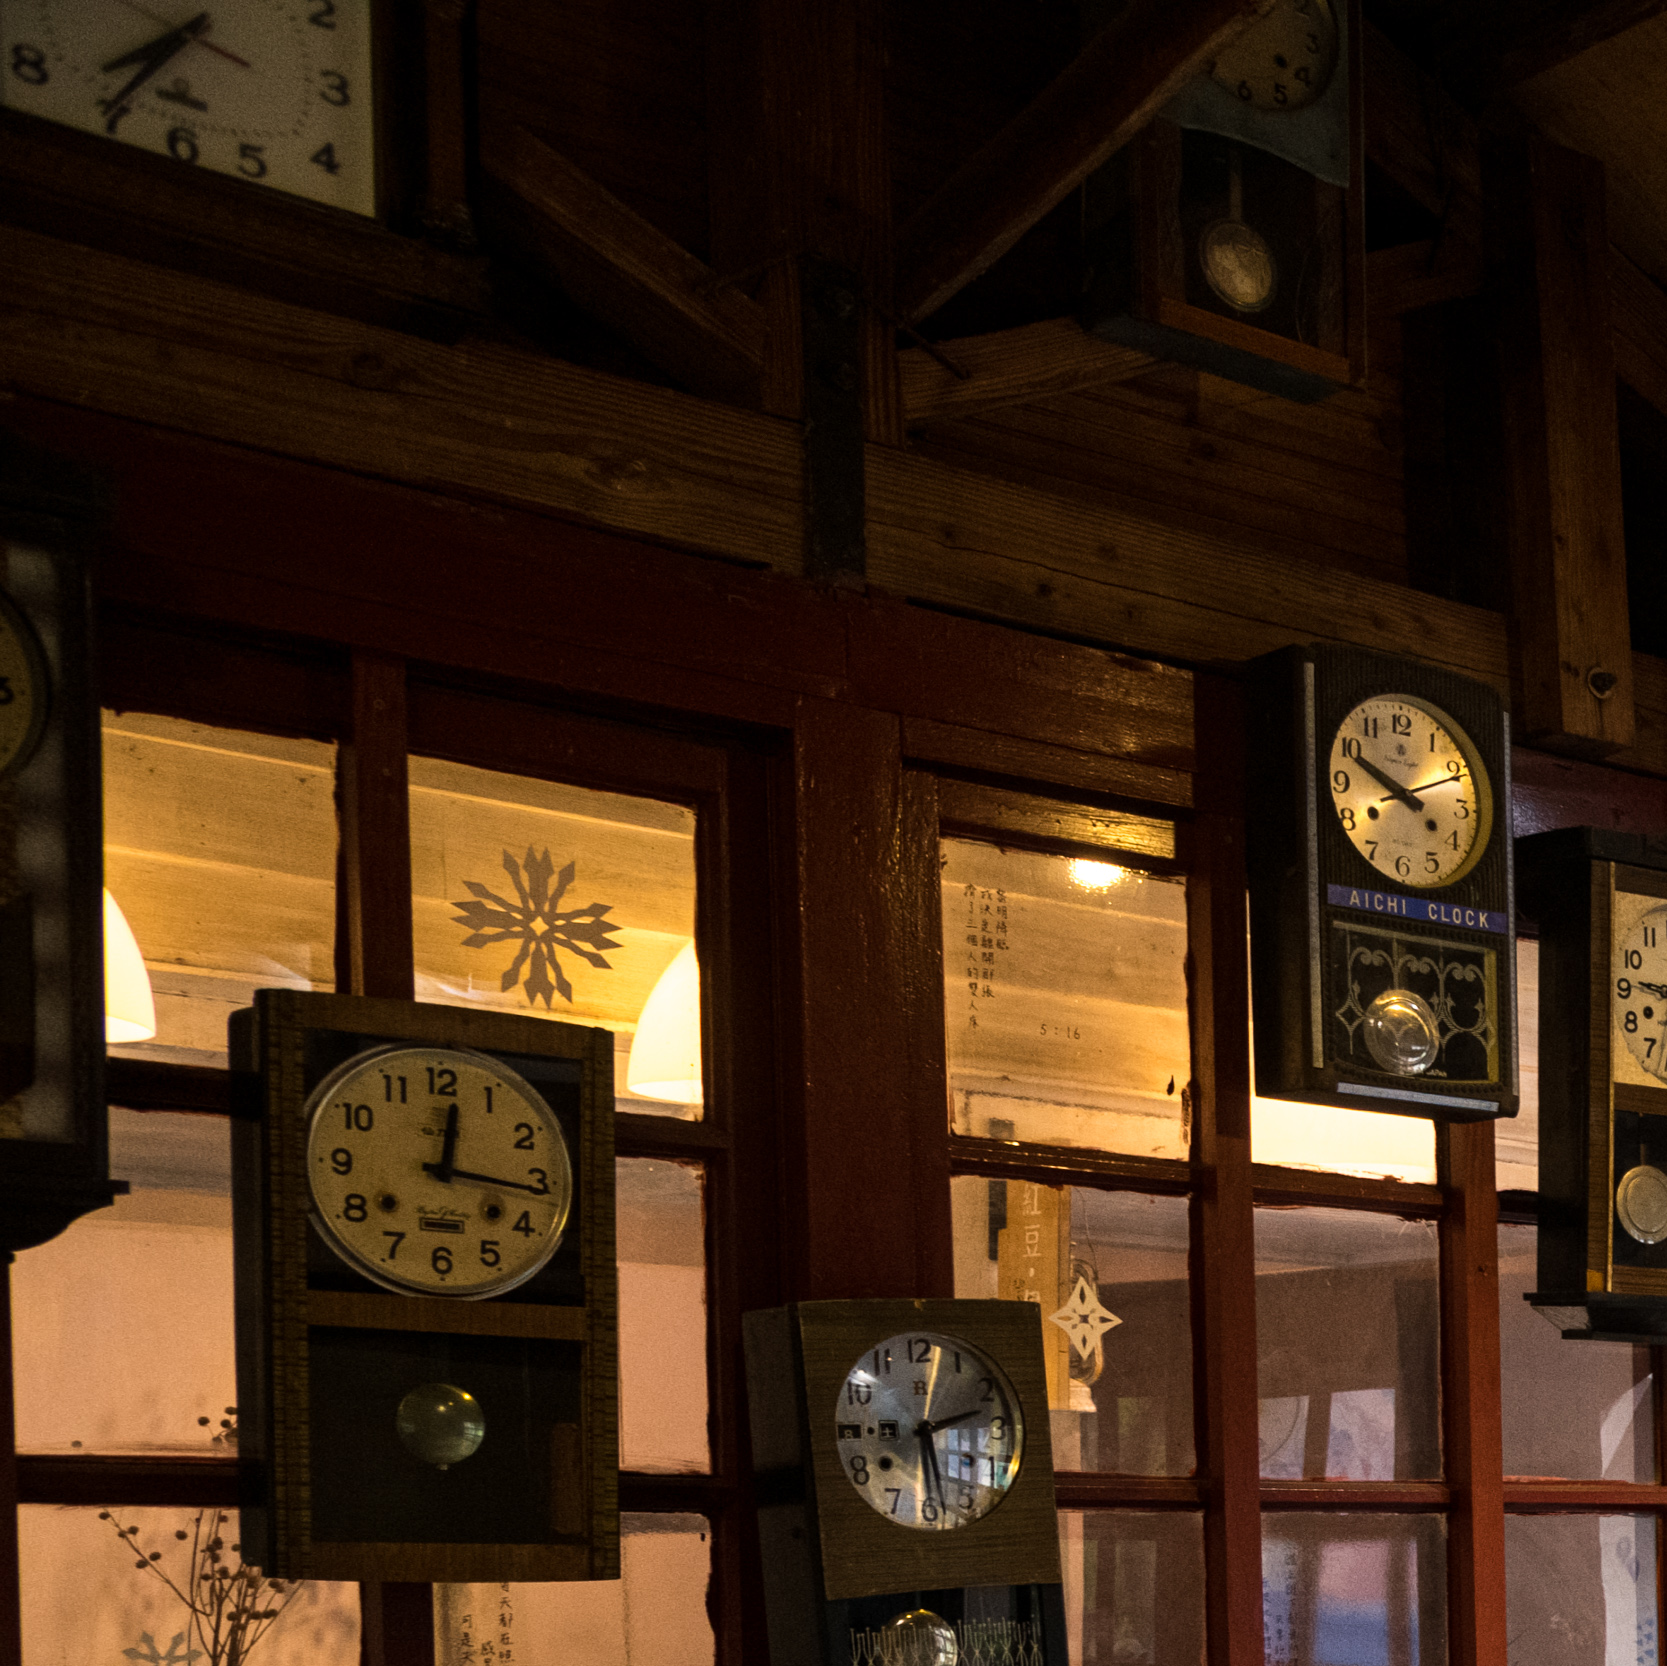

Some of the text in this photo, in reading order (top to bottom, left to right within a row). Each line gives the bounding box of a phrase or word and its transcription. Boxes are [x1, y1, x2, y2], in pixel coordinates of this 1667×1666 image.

[12, 44, 48, 85] 8
[320, 69, 351, 107] 3
[167, 126, 199, 165] 6
[310, 143, 340, 175] 4
[238, 143, 267, 178] 5
[1363, 717, 1378, 739] 11
[1392, 714, 1412, 736] 12
[1342, 737, 1361, 759] 10
[1333, 771, 1350, 794] 9
[1340, 808, 1356, 831] 8
[1454, 799, 1469, 820] 3
[1365, 840, 1378, 861] 7
[1445, 830, 1460, 851] 4
[1395, 856, 1411, 877] 6
[1424, 852, 1439, 873] 5
[1350, 890, 1490, 929] AICHI CLOCK
[1644, 926, 1656, 948] 11
[1625, 950, 1642, 969] 10
[1617, 978, 1631, 999] 9
[1624, 1011, 1638, 1033] 8
[1644, 1038, 1656, 1058] 7
[383, 1074, 407, 1104] 11
[426, 1067, 457, 1097] 12
[484, 1086, 493, 1114] 1
[343, 1102, 373, 1131] 10
[513, 1123, 535, 1150] 2
[331, 1148, 352, 1175] 9
[528, 1168, 549, 1195] 3
[343, 1194, 367, 1222] 8
[512, 1210, 535, 1237] 4
[383, 1231, 406, 1259] 7
[480, 1240, 500, 1267] 5
[432, 1247, 453, 1274] 6
[874, 1348, 891, 1376] 11
[907, 1338, 931, 1364] 12
[848, 1381, 871, 1405] 10
[978, 1378, 994, 1402] 2
[991, 1416, 1006, 1440] 3
[851, 1455, 870, 1485] 8
[885, 1488, 902, 1515] 7
[921, 1497, 938, 1522] 6
